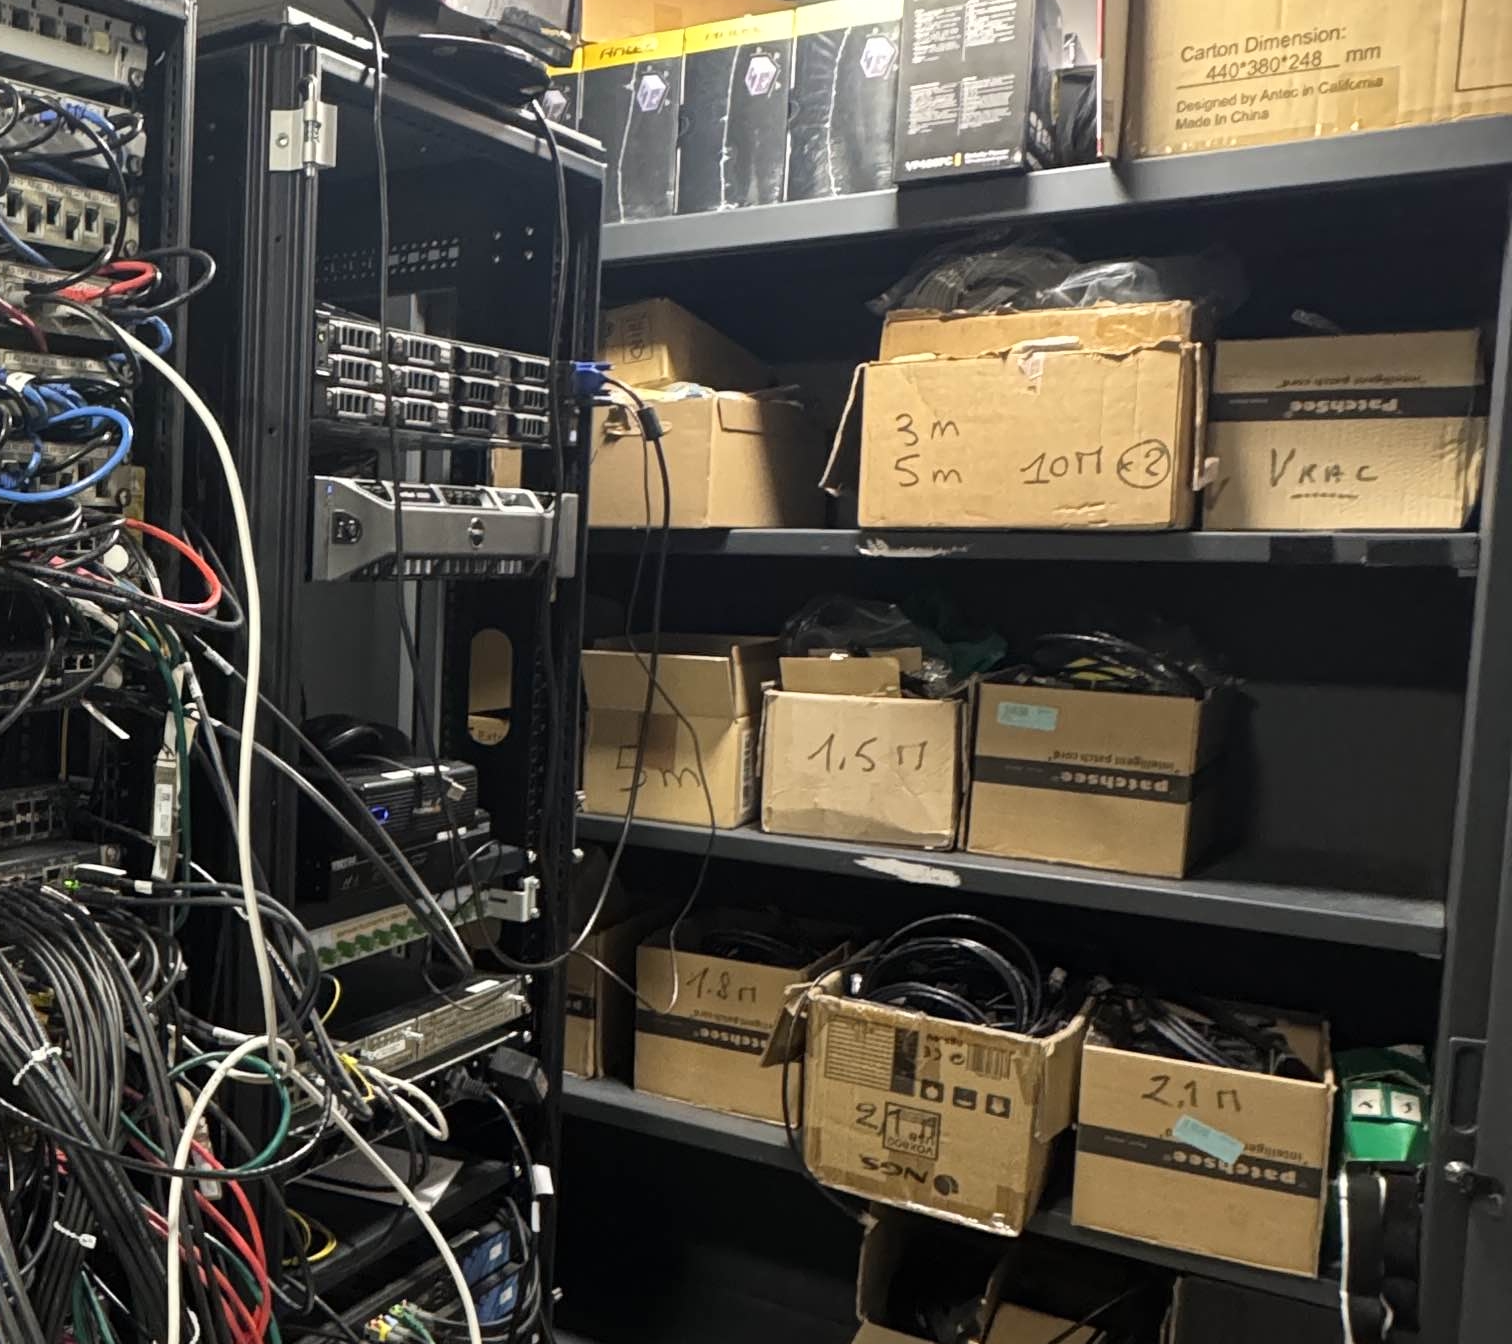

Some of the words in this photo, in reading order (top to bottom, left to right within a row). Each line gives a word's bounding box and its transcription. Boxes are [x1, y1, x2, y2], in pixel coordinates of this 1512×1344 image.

[1180, 41, 1239, 63] Carton
[1244, 27, 1347, 54] Dimension:
[1345, 45, 1382, 63] mm
[1176, 93, 1237, 114] Designed
[1240, 92, 1257, 107] by
[1260, 86, 1299, 102] Antec
[1302, 84, 1314, 97] in
[1317, 75, 1384, 96] California
[1175, 113, 1211, 130] Made
[1231, 108, 1270, 123] China
[895, 414, 919, 446] 3
[893, 454, 921, 487] 5
[616, 745, 647, 791] 5
[1078, 752, 1114, 765] patch
[1142, 1075, 1199, 1109] 2,1
[859, 1154, 929, 1184] NGS
